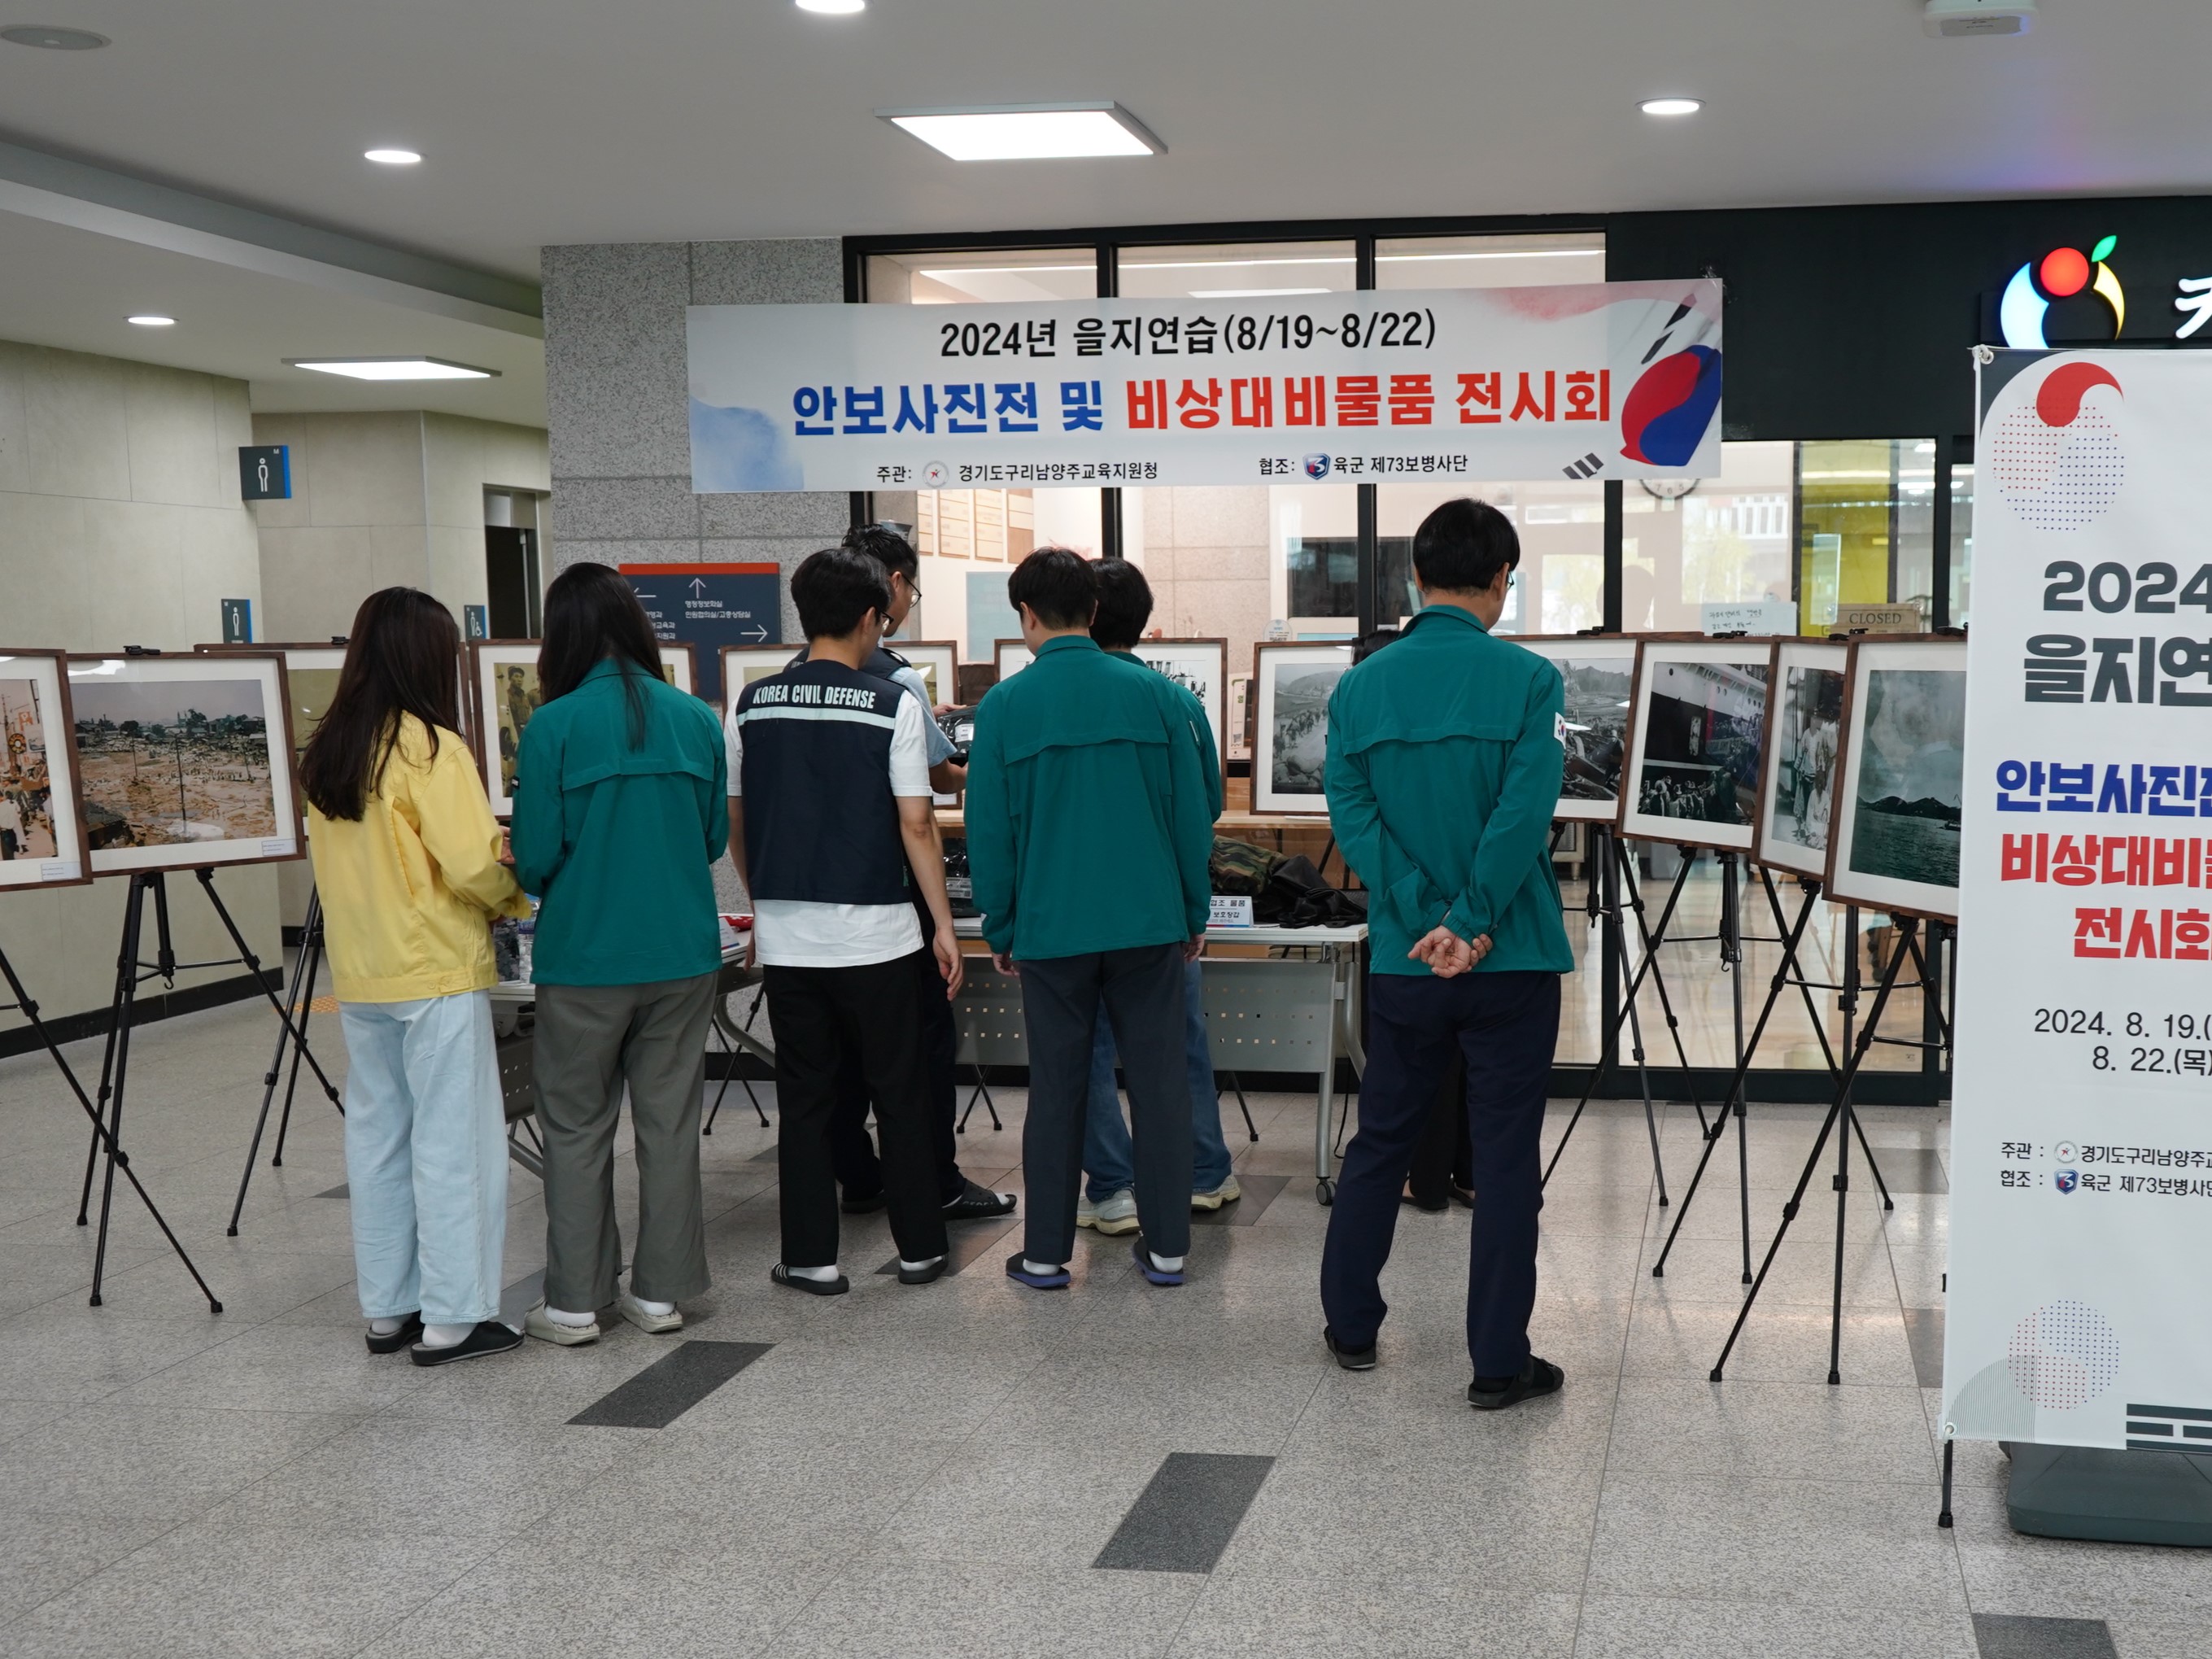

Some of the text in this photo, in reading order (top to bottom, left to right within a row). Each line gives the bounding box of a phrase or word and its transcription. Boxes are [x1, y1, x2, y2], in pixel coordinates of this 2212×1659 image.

[940, 308, 1436, 358] 2024년 을지연습(8/19~8/22)
[792, 369, 1611, 436] 안보사진전 및 비상대비물품 전시회
[876, 461, 1158, 483] 주관: 경기도구리남양주교육지원청
[1259, 457, 1295, 476] 협조:
[1333, 456, 1364, 474] 육군
[1370, 454, 1468, 474] 제73보병사단
[2043, 560, 2212, 614] 2024
[1848, 612, 1903, 625] CLOSED
[752, 684, 876, 709] KOREA CIVIL DEFENSE
[1996, 759, 2212, 818] 안보사진
[2000, 832, 2212, 890] 비상대비
[2074, 906, 2212, 961] 전시회
[2034, 1008, 2112, 1037] 2024.
[2126, 1011, 2150, 1038] 8.
[2092, 1045, 2116, 1072] 8.
[2000, 1142, 2032, 1160] 주관
[2000, 1169, 2031, 1188] 협조
[2080, 1173, 2111, 1192] 육군
